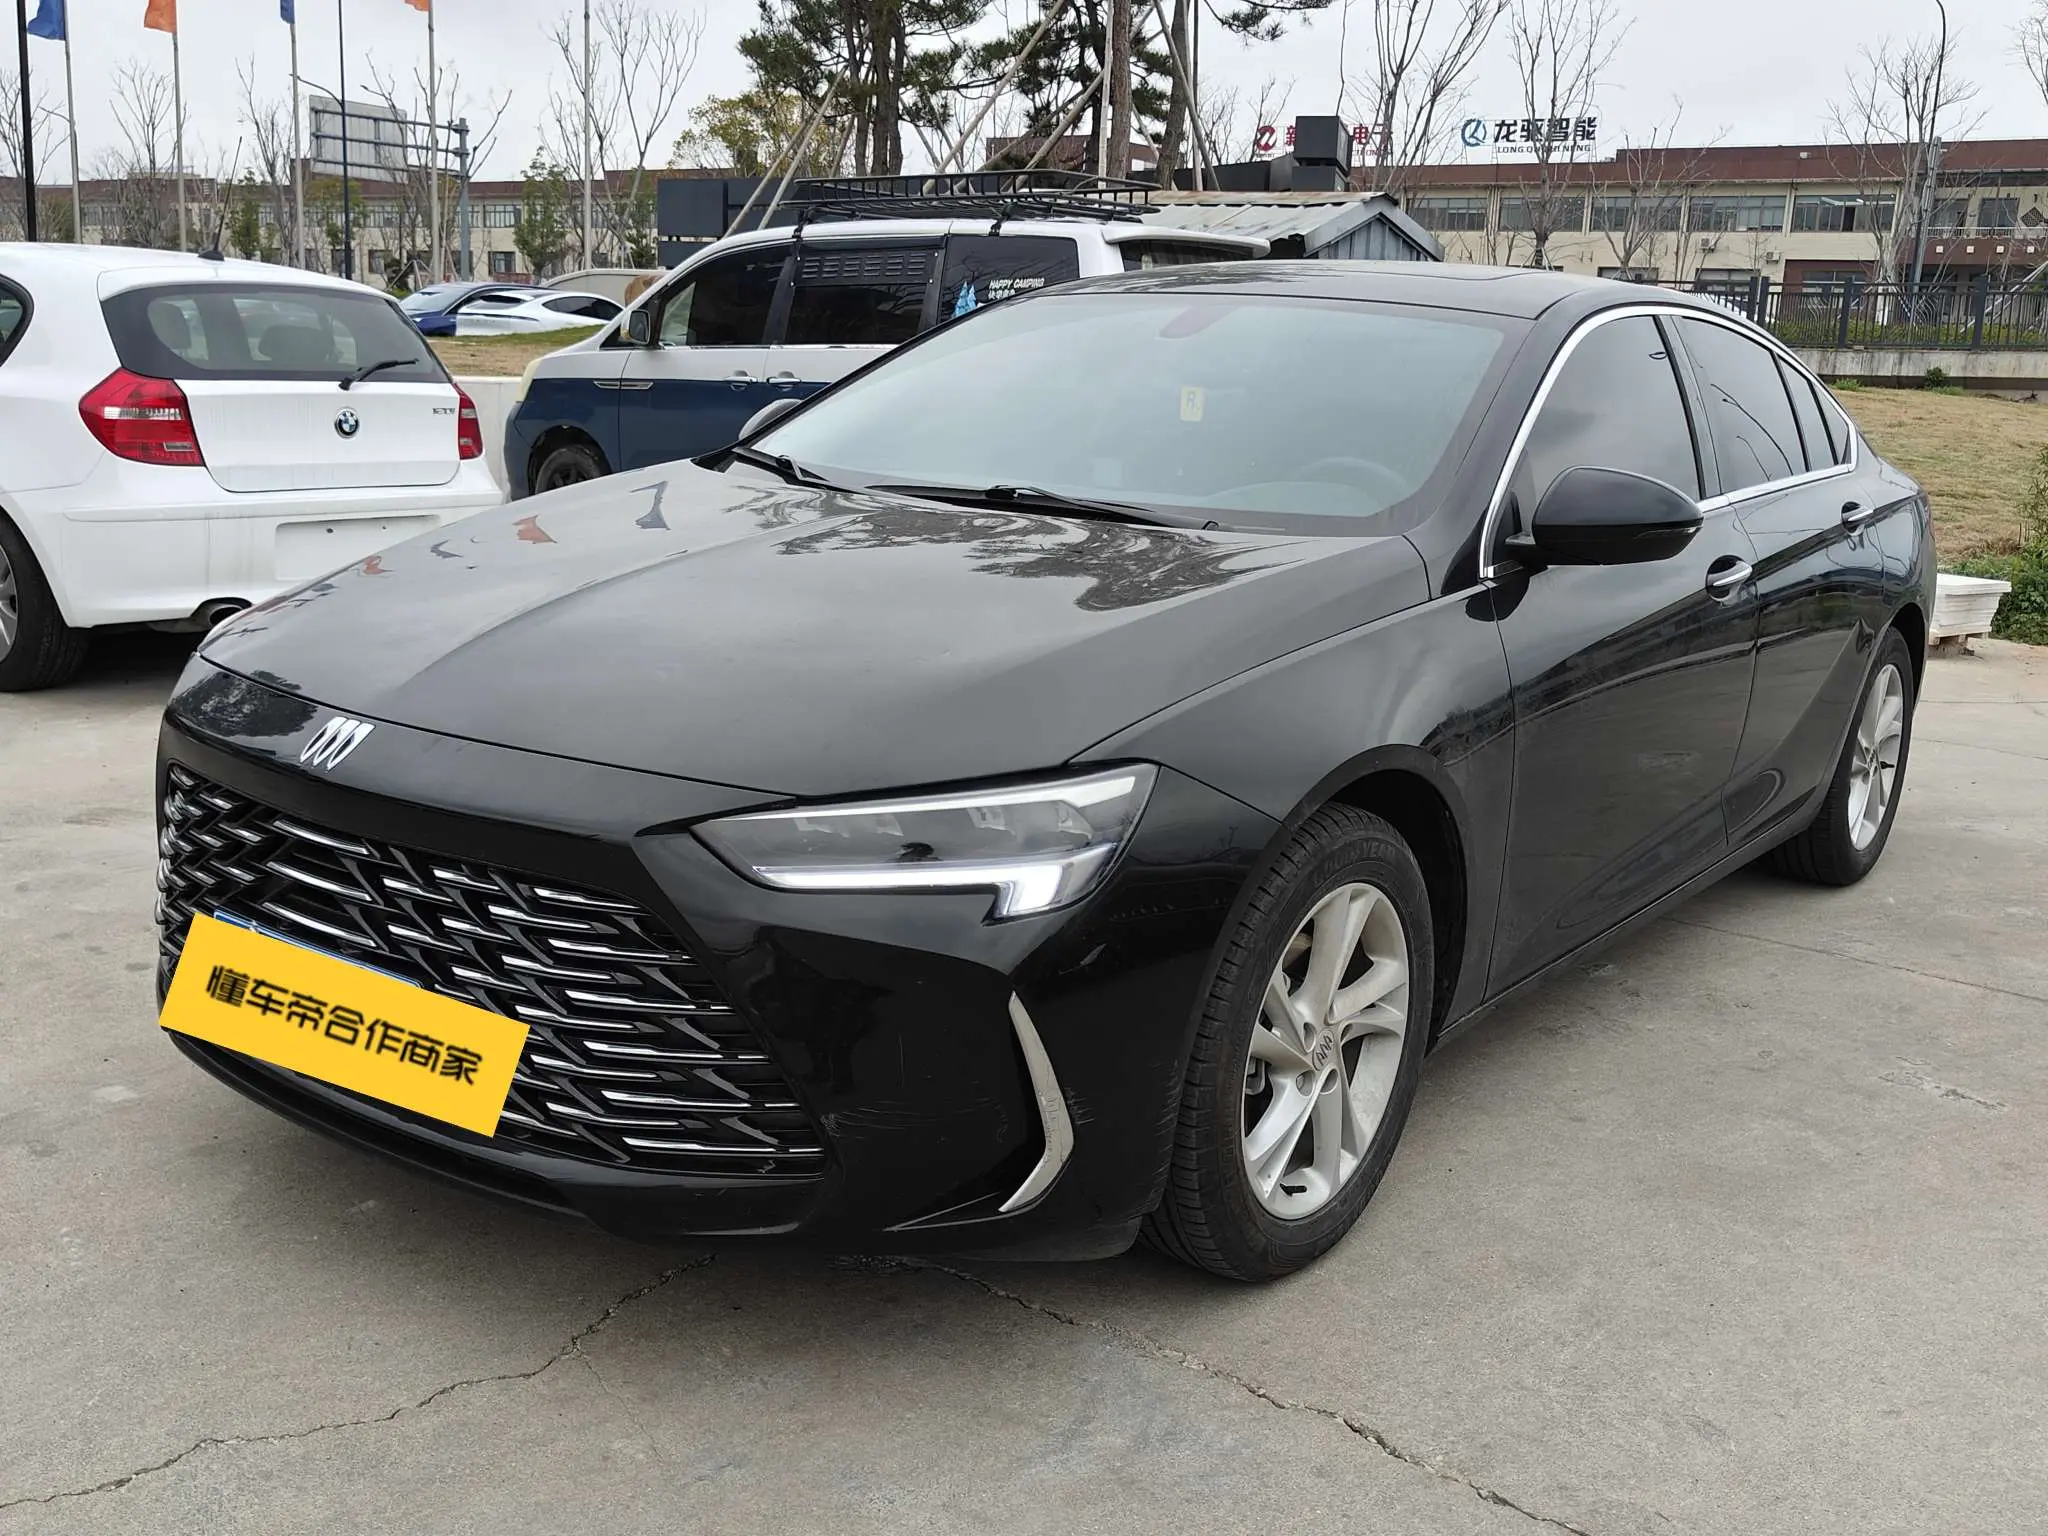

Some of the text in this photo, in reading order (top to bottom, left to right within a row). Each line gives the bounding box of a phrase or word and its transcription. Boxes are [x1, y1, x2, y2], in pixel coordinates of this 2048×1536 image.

[1494, 117, 1597, 143] 龙驱智能
[989, 279, 1014, 290] HAPPY
